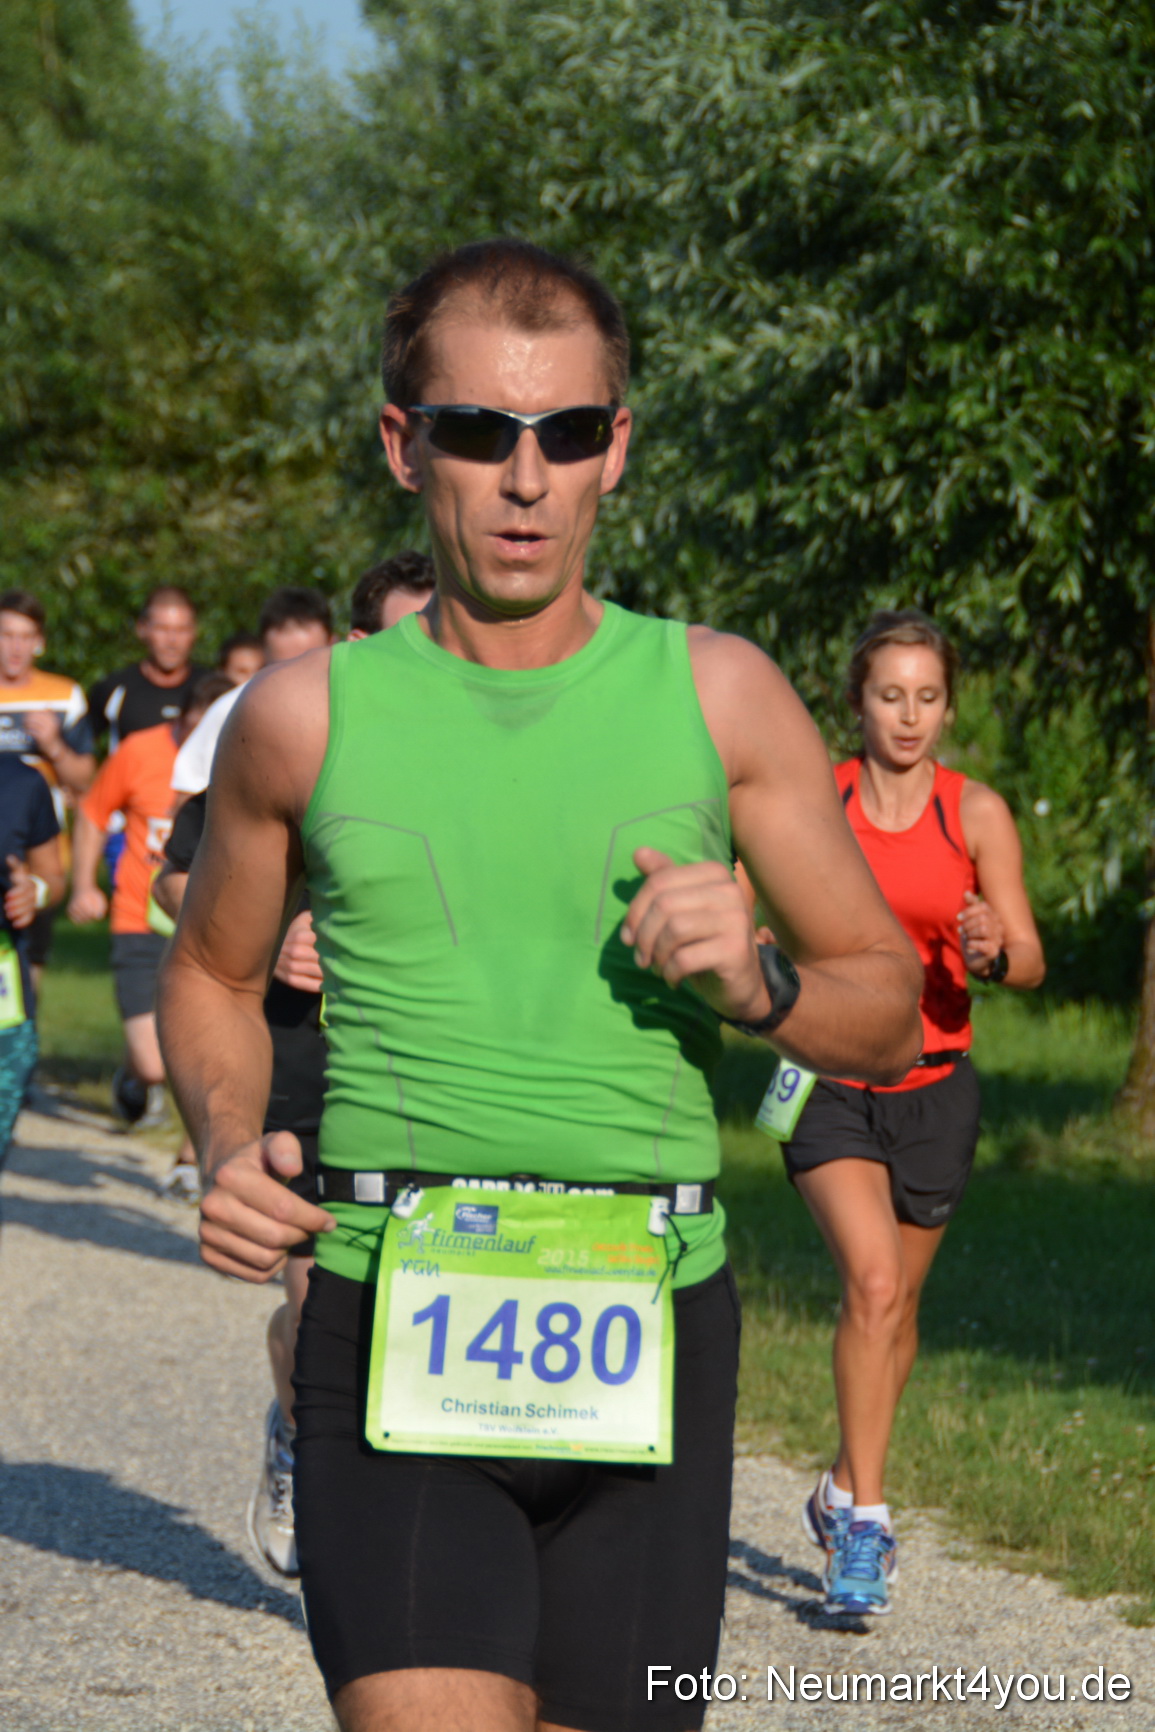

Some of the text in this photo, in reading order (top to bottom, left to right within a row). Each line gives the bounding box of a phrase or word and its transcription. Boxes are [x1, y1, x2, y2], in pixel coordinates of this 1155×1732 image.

[431, 1228, 537, 1254] firmenlauf
[537, 1247, 590, 1267] 2015
[412, 1294, 642, 1386] 1480
[441, 1398, 599, 1420] Christian Schimek
[478, 1423, 497, 1432] TSV
